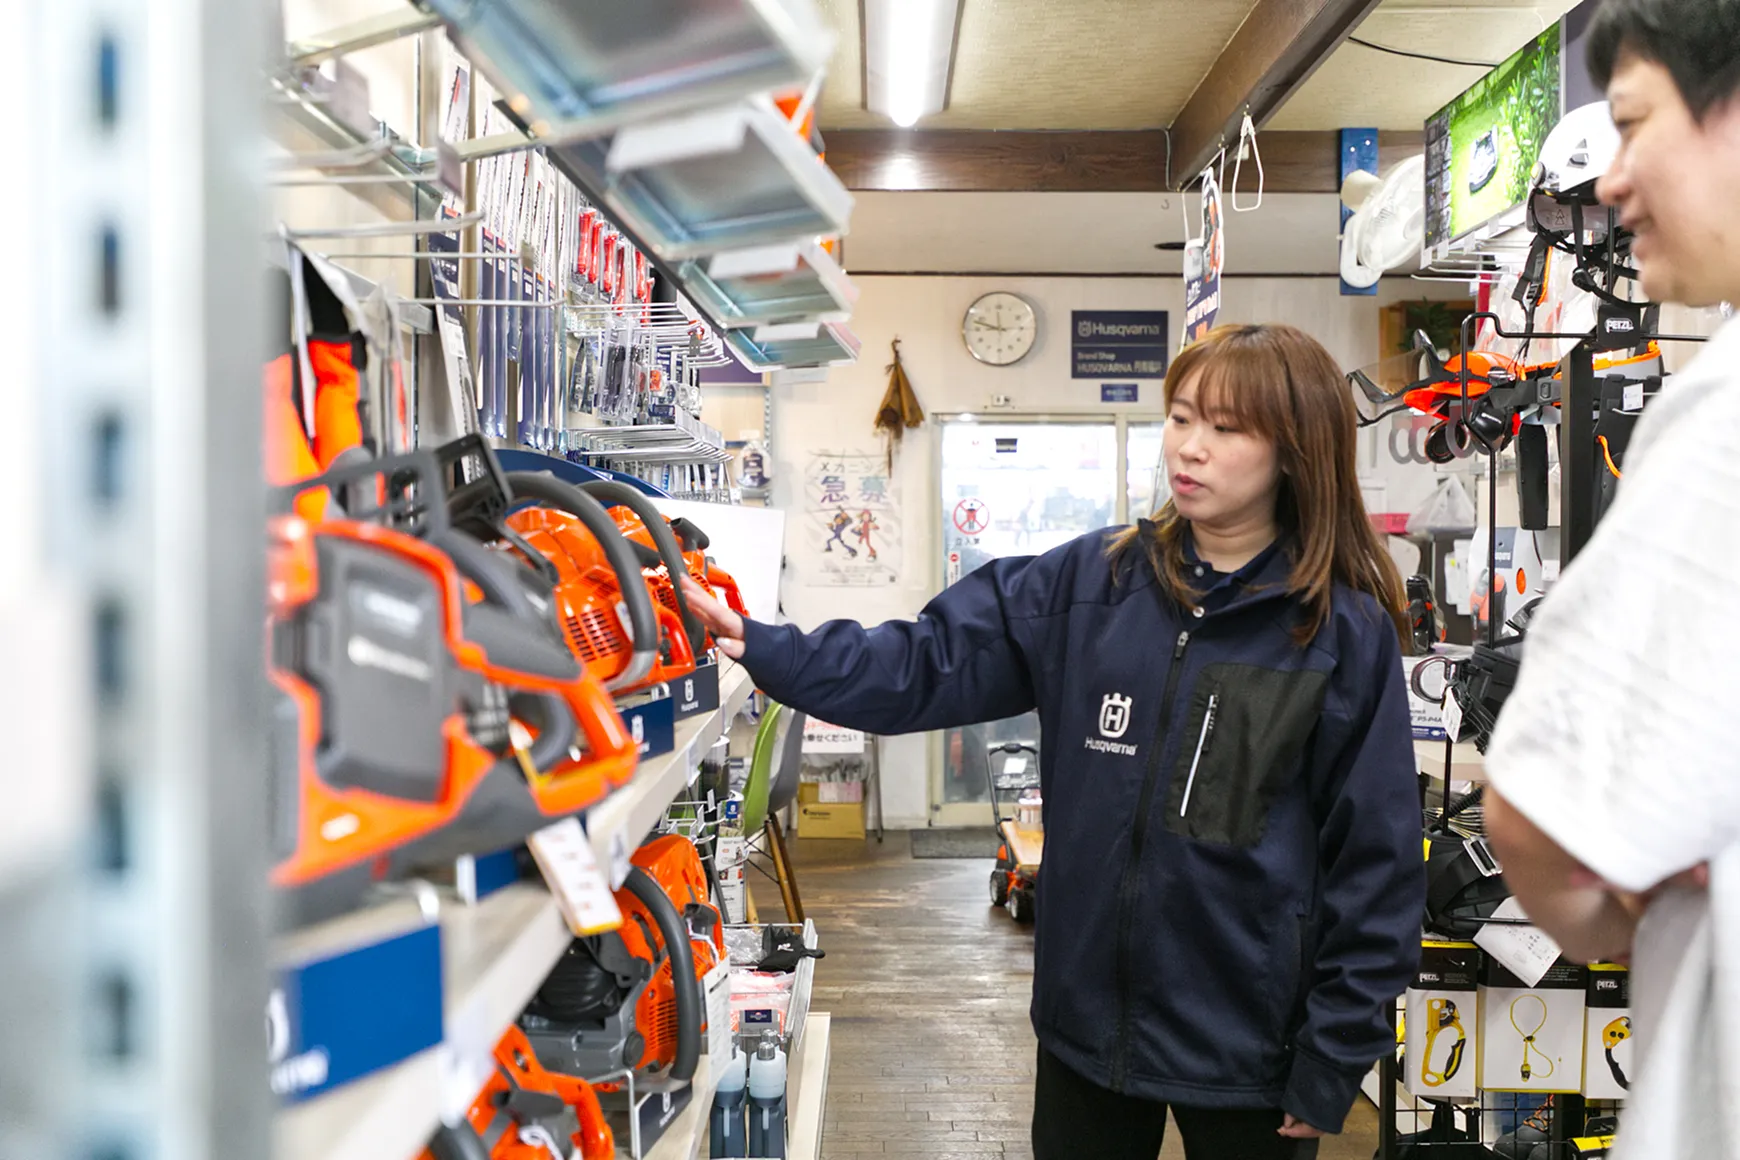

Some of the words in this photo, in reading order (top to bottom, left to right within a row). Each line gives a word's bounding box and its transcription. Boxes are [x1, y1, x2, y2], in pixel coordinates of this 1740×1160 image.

[1092, 321, 1159, 337] Husqvarna
[1605, 318, 1634, 333] PETZL
[1084, 737, 1138, 756] Husqvarna
[1419, 972, 1440, 983] PETZL
[1596, 980, 1618, 990] PETZL
